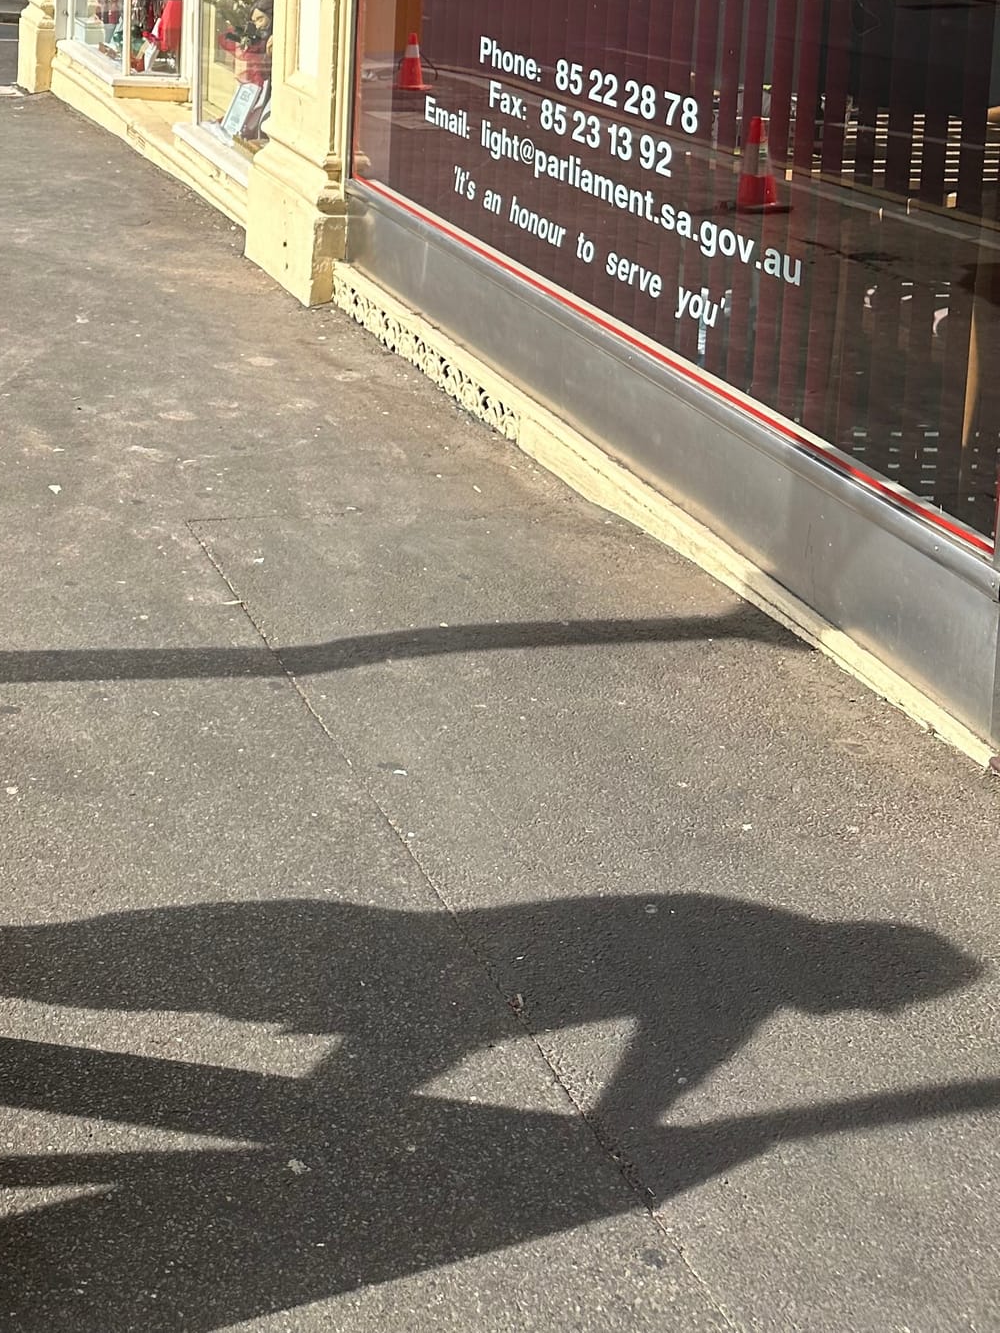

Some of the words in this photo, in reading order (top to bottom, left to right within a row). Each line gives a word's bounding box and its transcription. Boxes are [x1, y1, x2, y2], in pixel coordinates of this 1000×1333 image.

[479, 35, 542, 83] Phone:
[554, 58, 584, 96] 85
[589, 71, 618, 108] 22
[624, 79, 656, 121] 28
[663, 90, 698, 135] 78
[489, 80, 527, 122] Fax:
[540, 99, 567, 137] 85
[572, 110, 602, 150] 23
[607, 122, 633, 161] 13
[639, 133, 672, 178] 92
[424, 95, 470, 141] Email:
[481, 119, 802, 287] light@parliament.sa.gov.au
[483, 188, 502, 215] an
[509, 195, 566, 249] honour
[577, 232, 594, 264] to
[606, 251, 662, 301] serve
